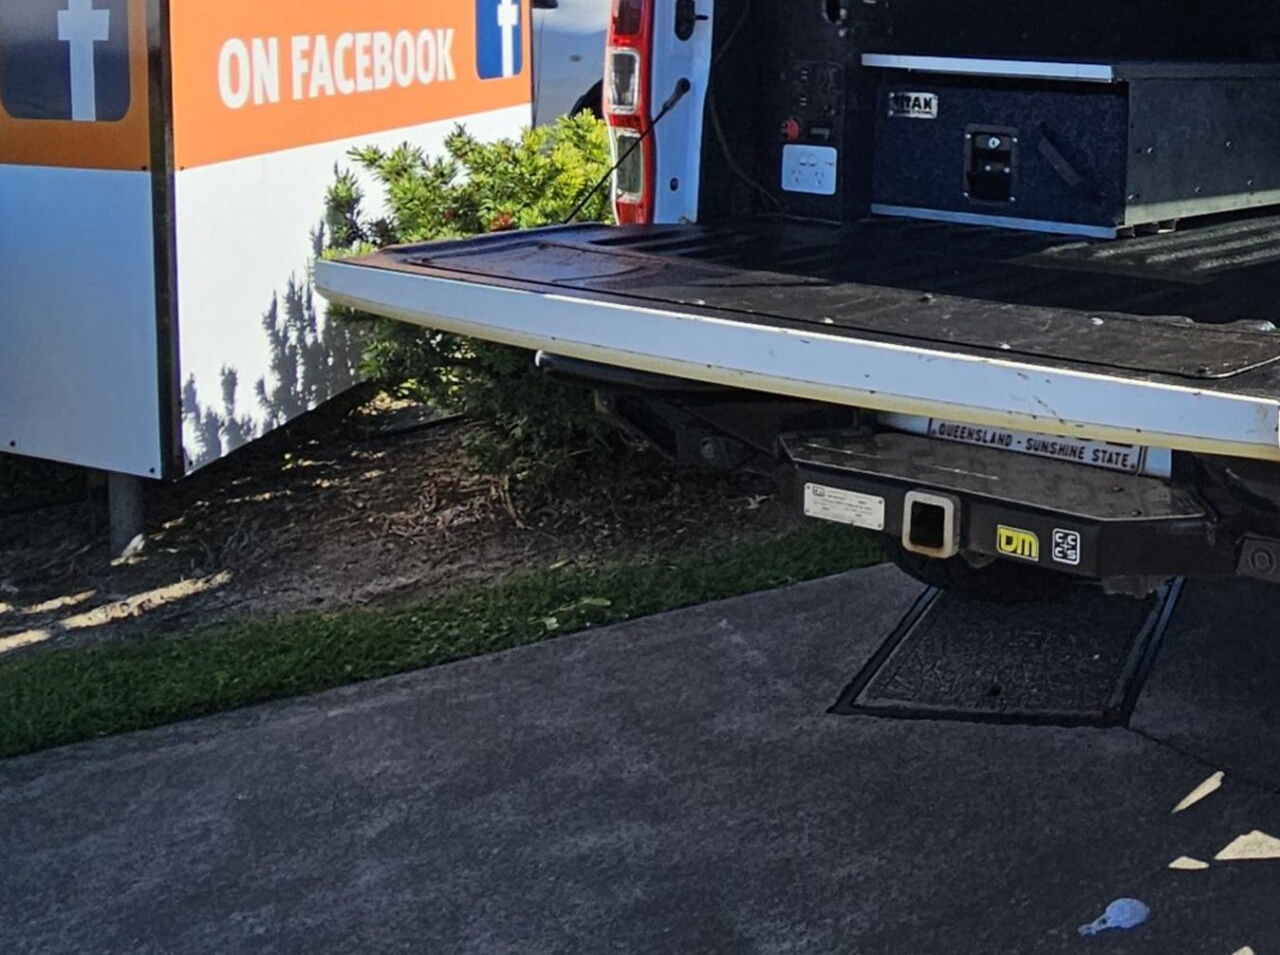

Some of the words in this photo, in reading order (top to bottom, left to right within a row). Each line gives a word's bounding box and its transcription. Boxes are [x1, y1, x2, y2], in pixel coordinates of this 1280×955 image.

[217, 36, 280, 110] ON
[291, 28, 457, 101] FACEBOOK
[938, 422, 1013, 447] QUEENSLAND
[1025, 437, 1086, 461] SUNSHINE
[1091, 448, 1130, 468] STATE
